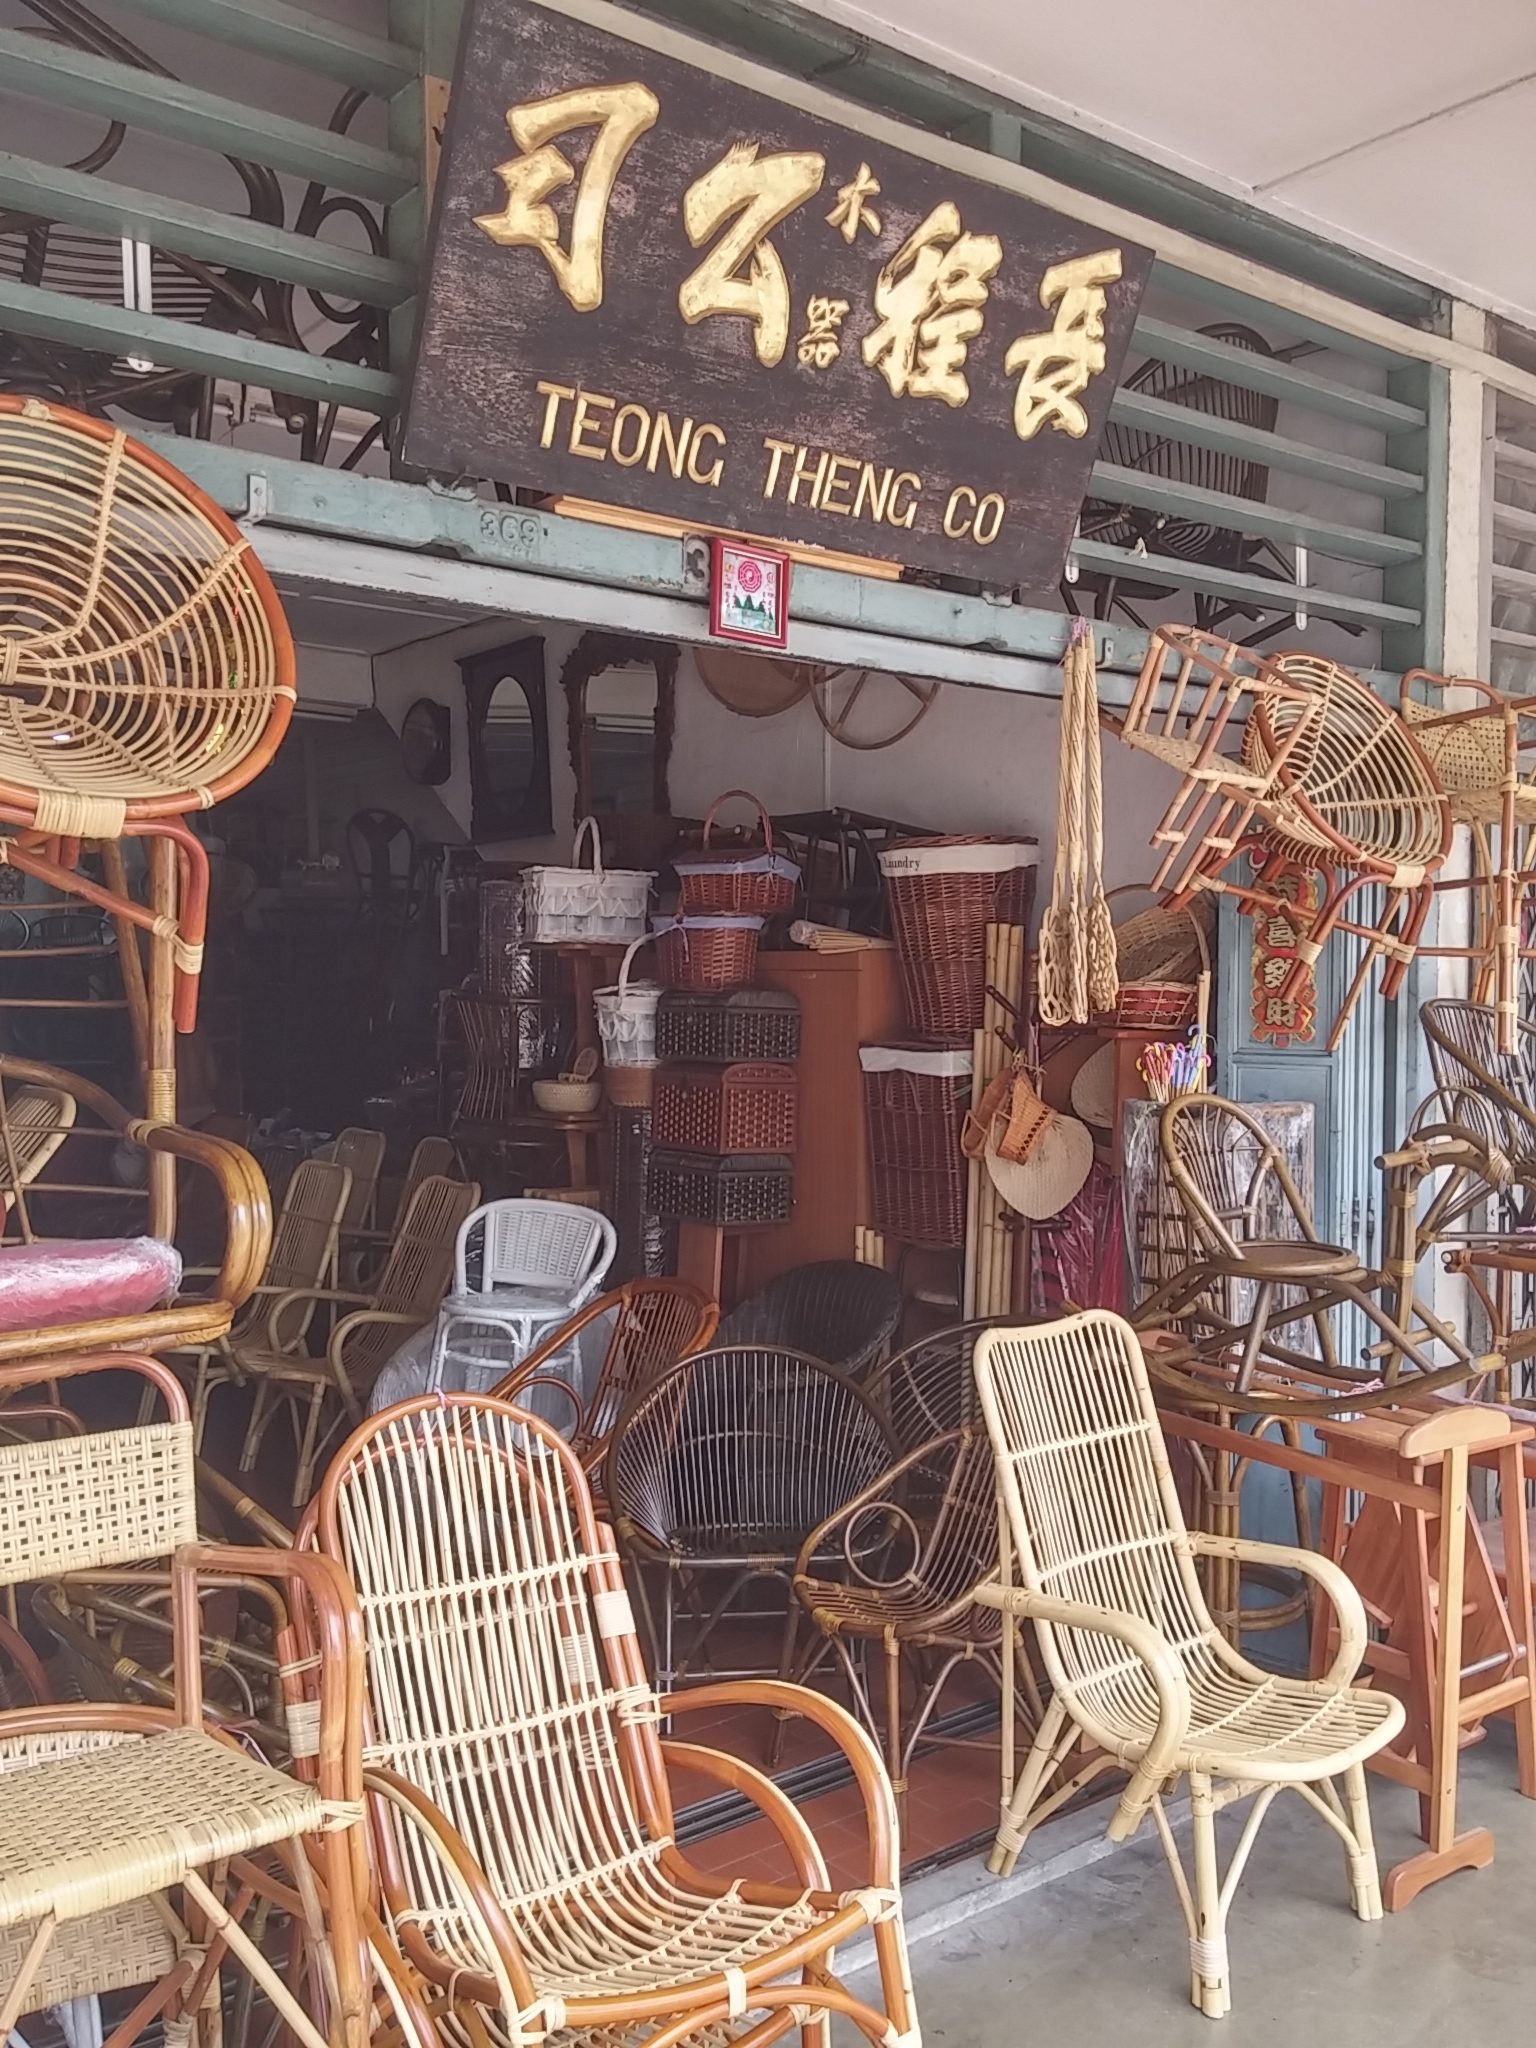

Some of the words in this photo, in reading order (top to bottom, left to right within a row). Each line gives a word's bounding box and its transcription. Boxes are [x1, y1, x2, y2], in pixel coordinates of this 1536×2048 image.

[536, 380, 726, 487] TEONG
[762, 437, 922, 529] THENG
[943, 486, 1005, 545] CO
